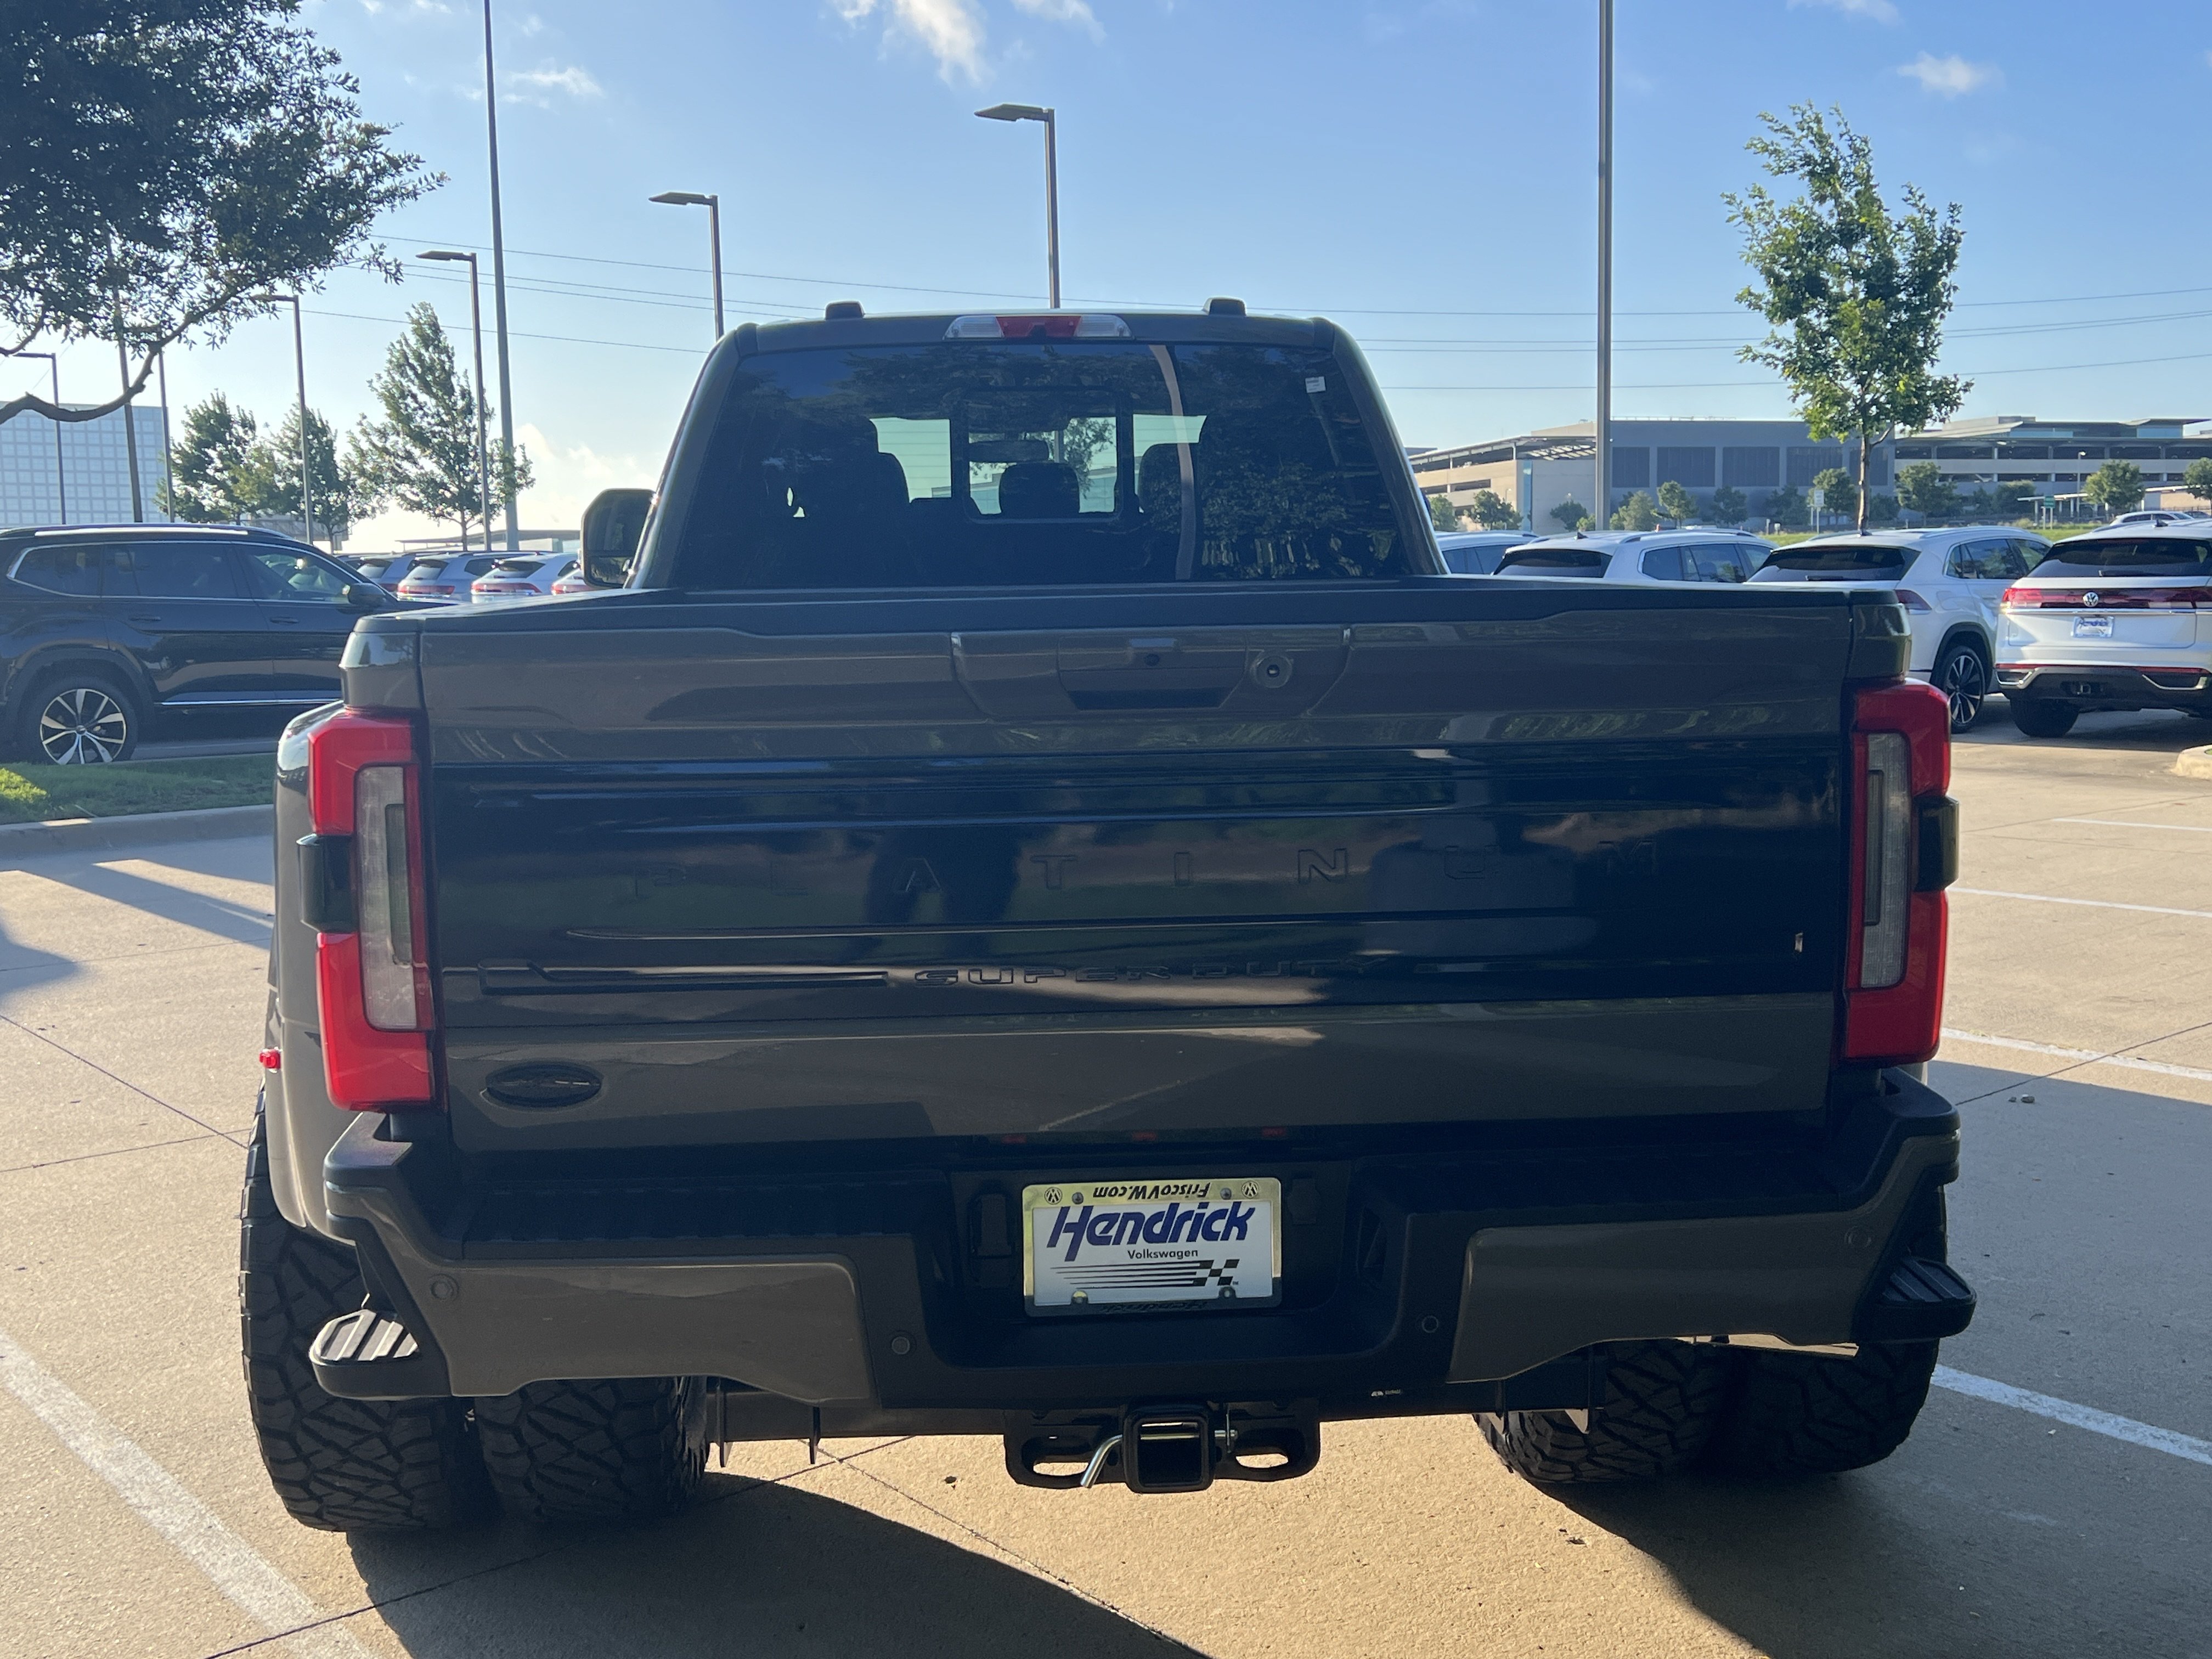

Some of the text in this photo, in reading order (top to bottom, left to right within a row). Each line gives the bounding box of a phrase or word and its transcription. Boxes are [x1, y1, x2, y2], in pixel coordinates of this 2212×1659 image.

[915, 957, 1387, 986] SUPER DUTY
[1093, 1182, 1211, 1200] FriscoVW.com
[1046, 1201, 1256, 1262] Hendrick
[1127, 1249, 1198, 1260] Volkswagen
